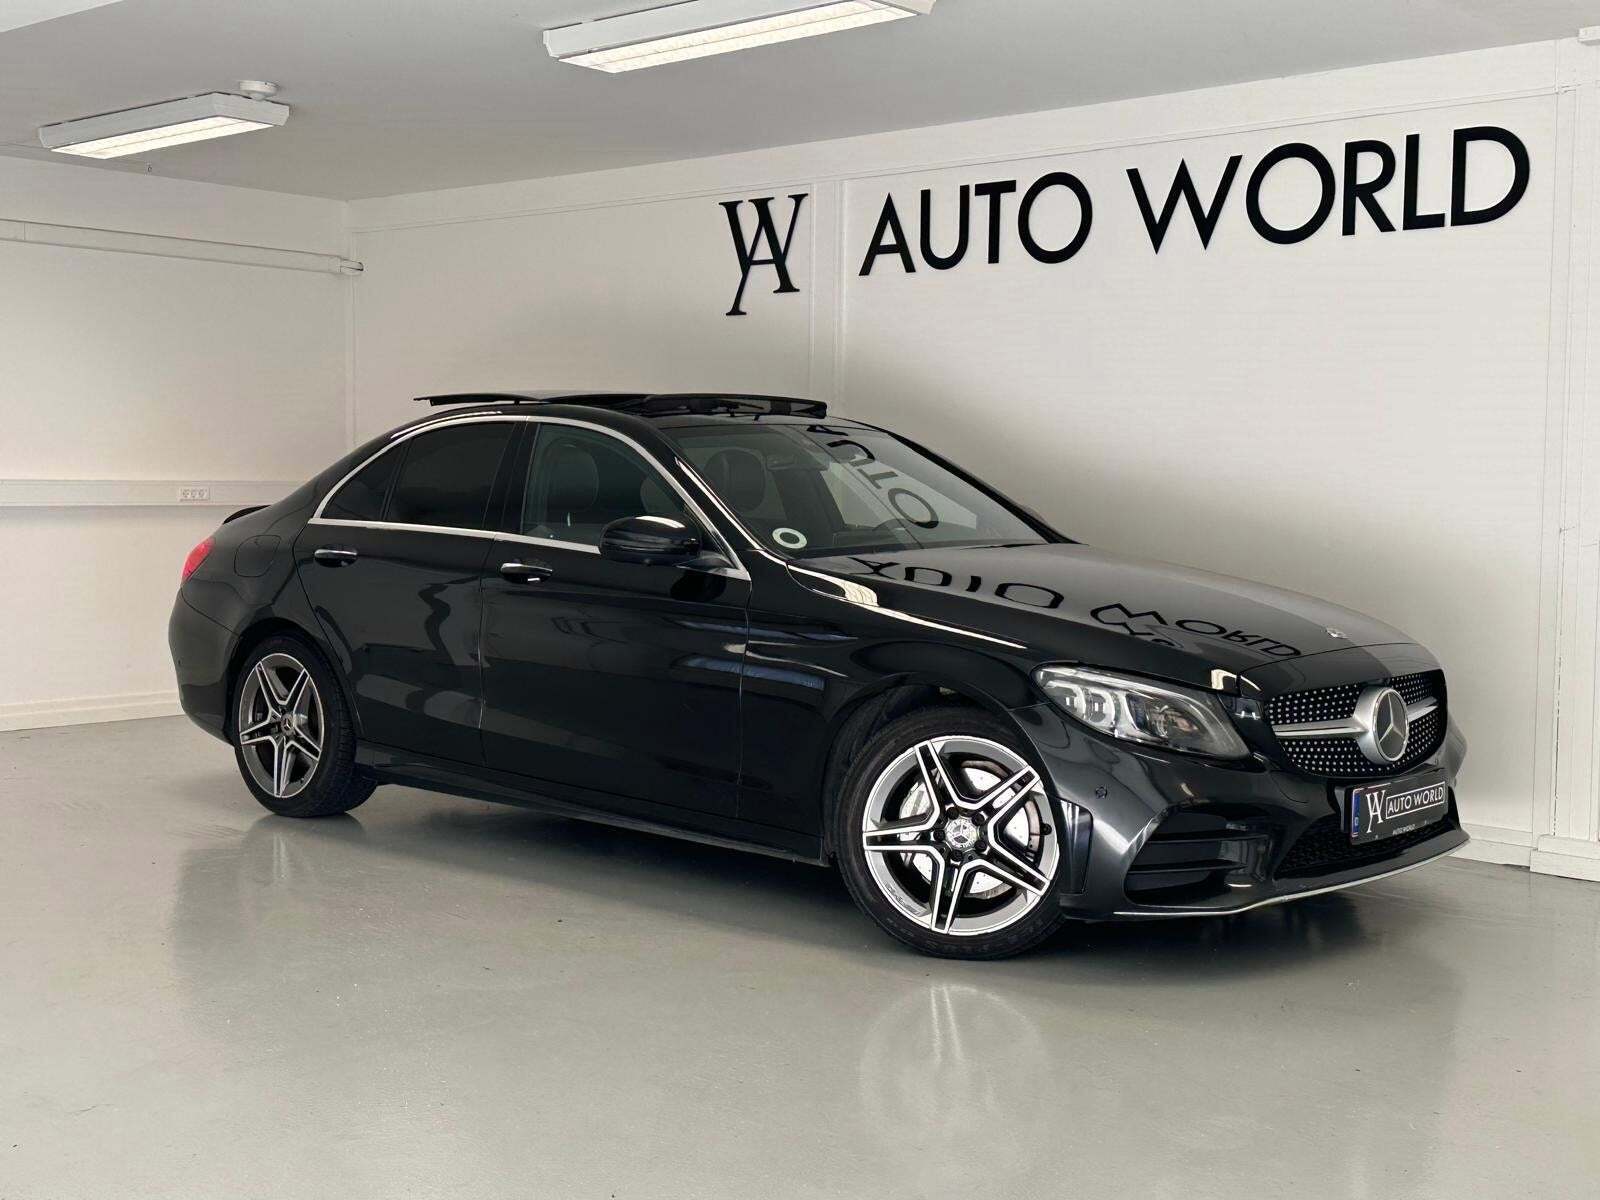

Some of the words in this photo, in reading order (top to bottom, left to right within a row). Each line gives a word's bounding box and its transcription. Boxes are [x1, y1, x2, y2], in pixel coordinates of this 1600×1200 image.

[858, 171, 1093, 277] AUTO
[1125, 125, 1531, 255] WORLD
[1388, 795, 1412, 814] AUTO
[1413, 786, 1444, 806] WORLD
